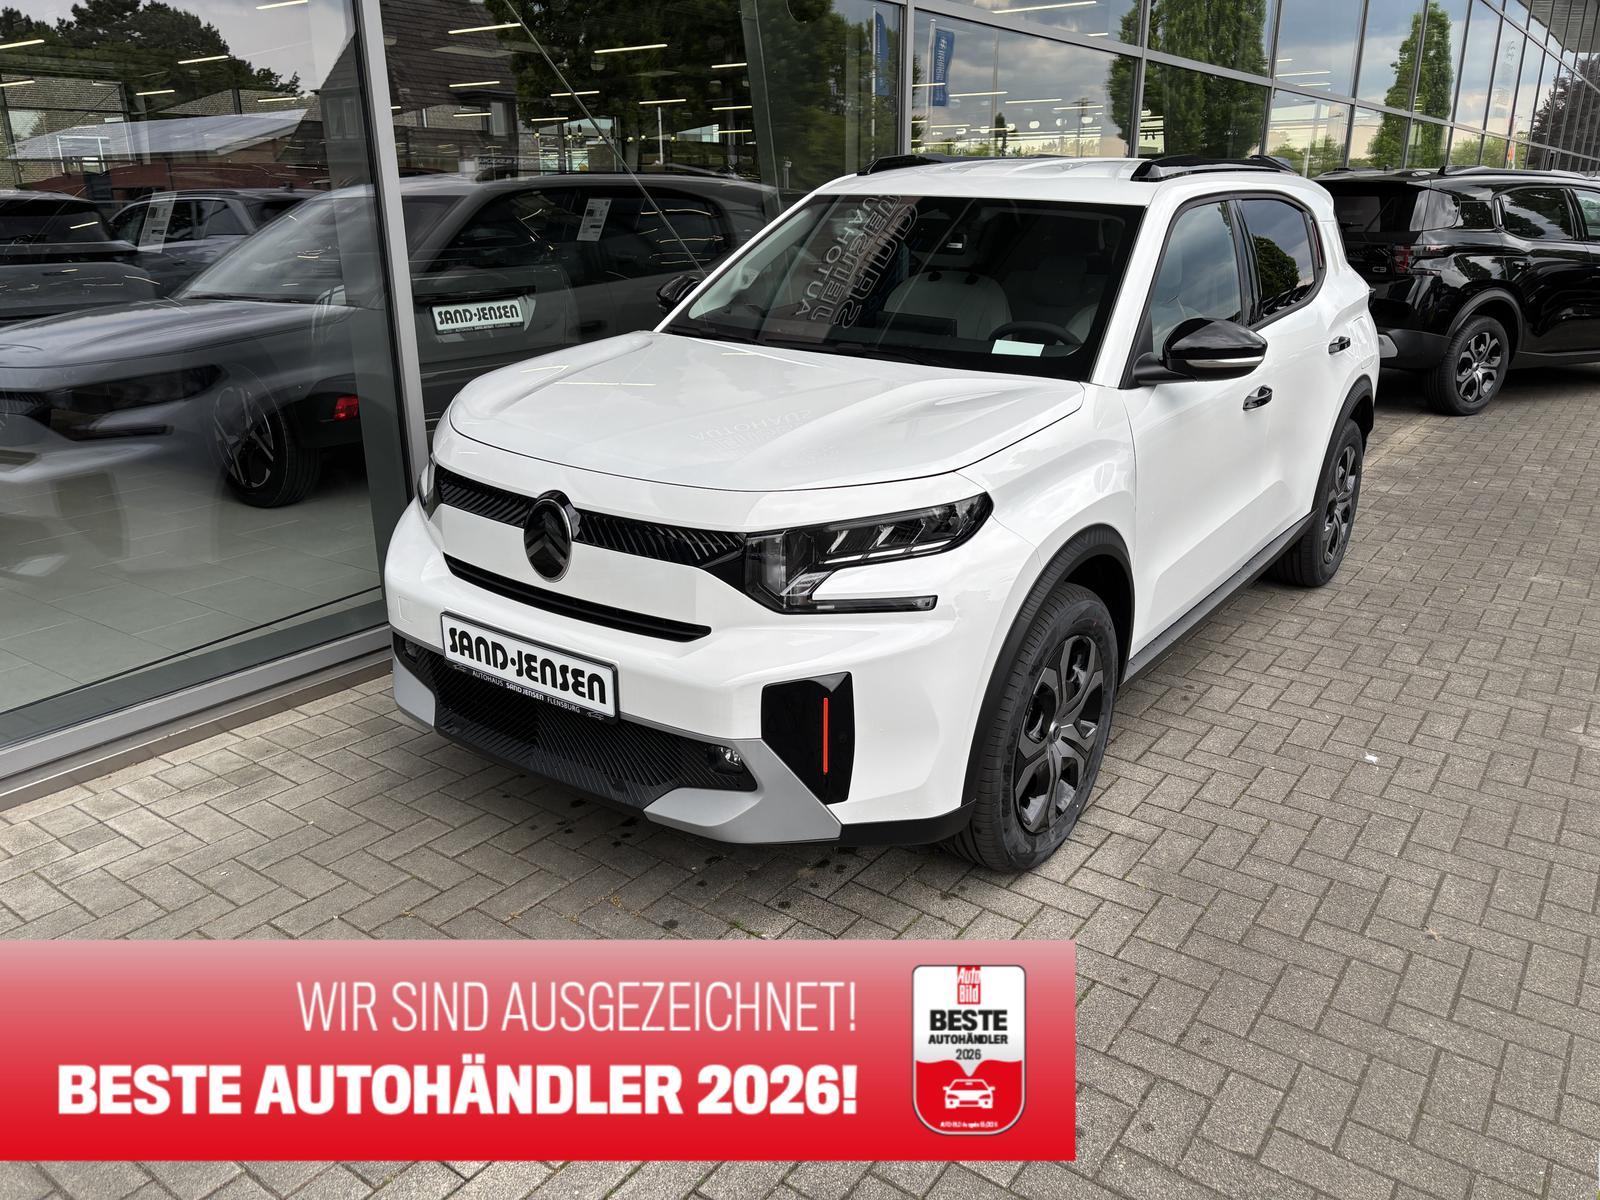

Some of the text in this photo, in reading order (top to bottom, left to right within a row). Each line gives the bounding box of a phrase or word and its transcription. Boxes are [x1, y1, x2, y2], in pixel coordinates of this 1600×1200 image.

[472, 670, 581, 714] AUTOHAUS SAND JENSEN FLENSBURG
